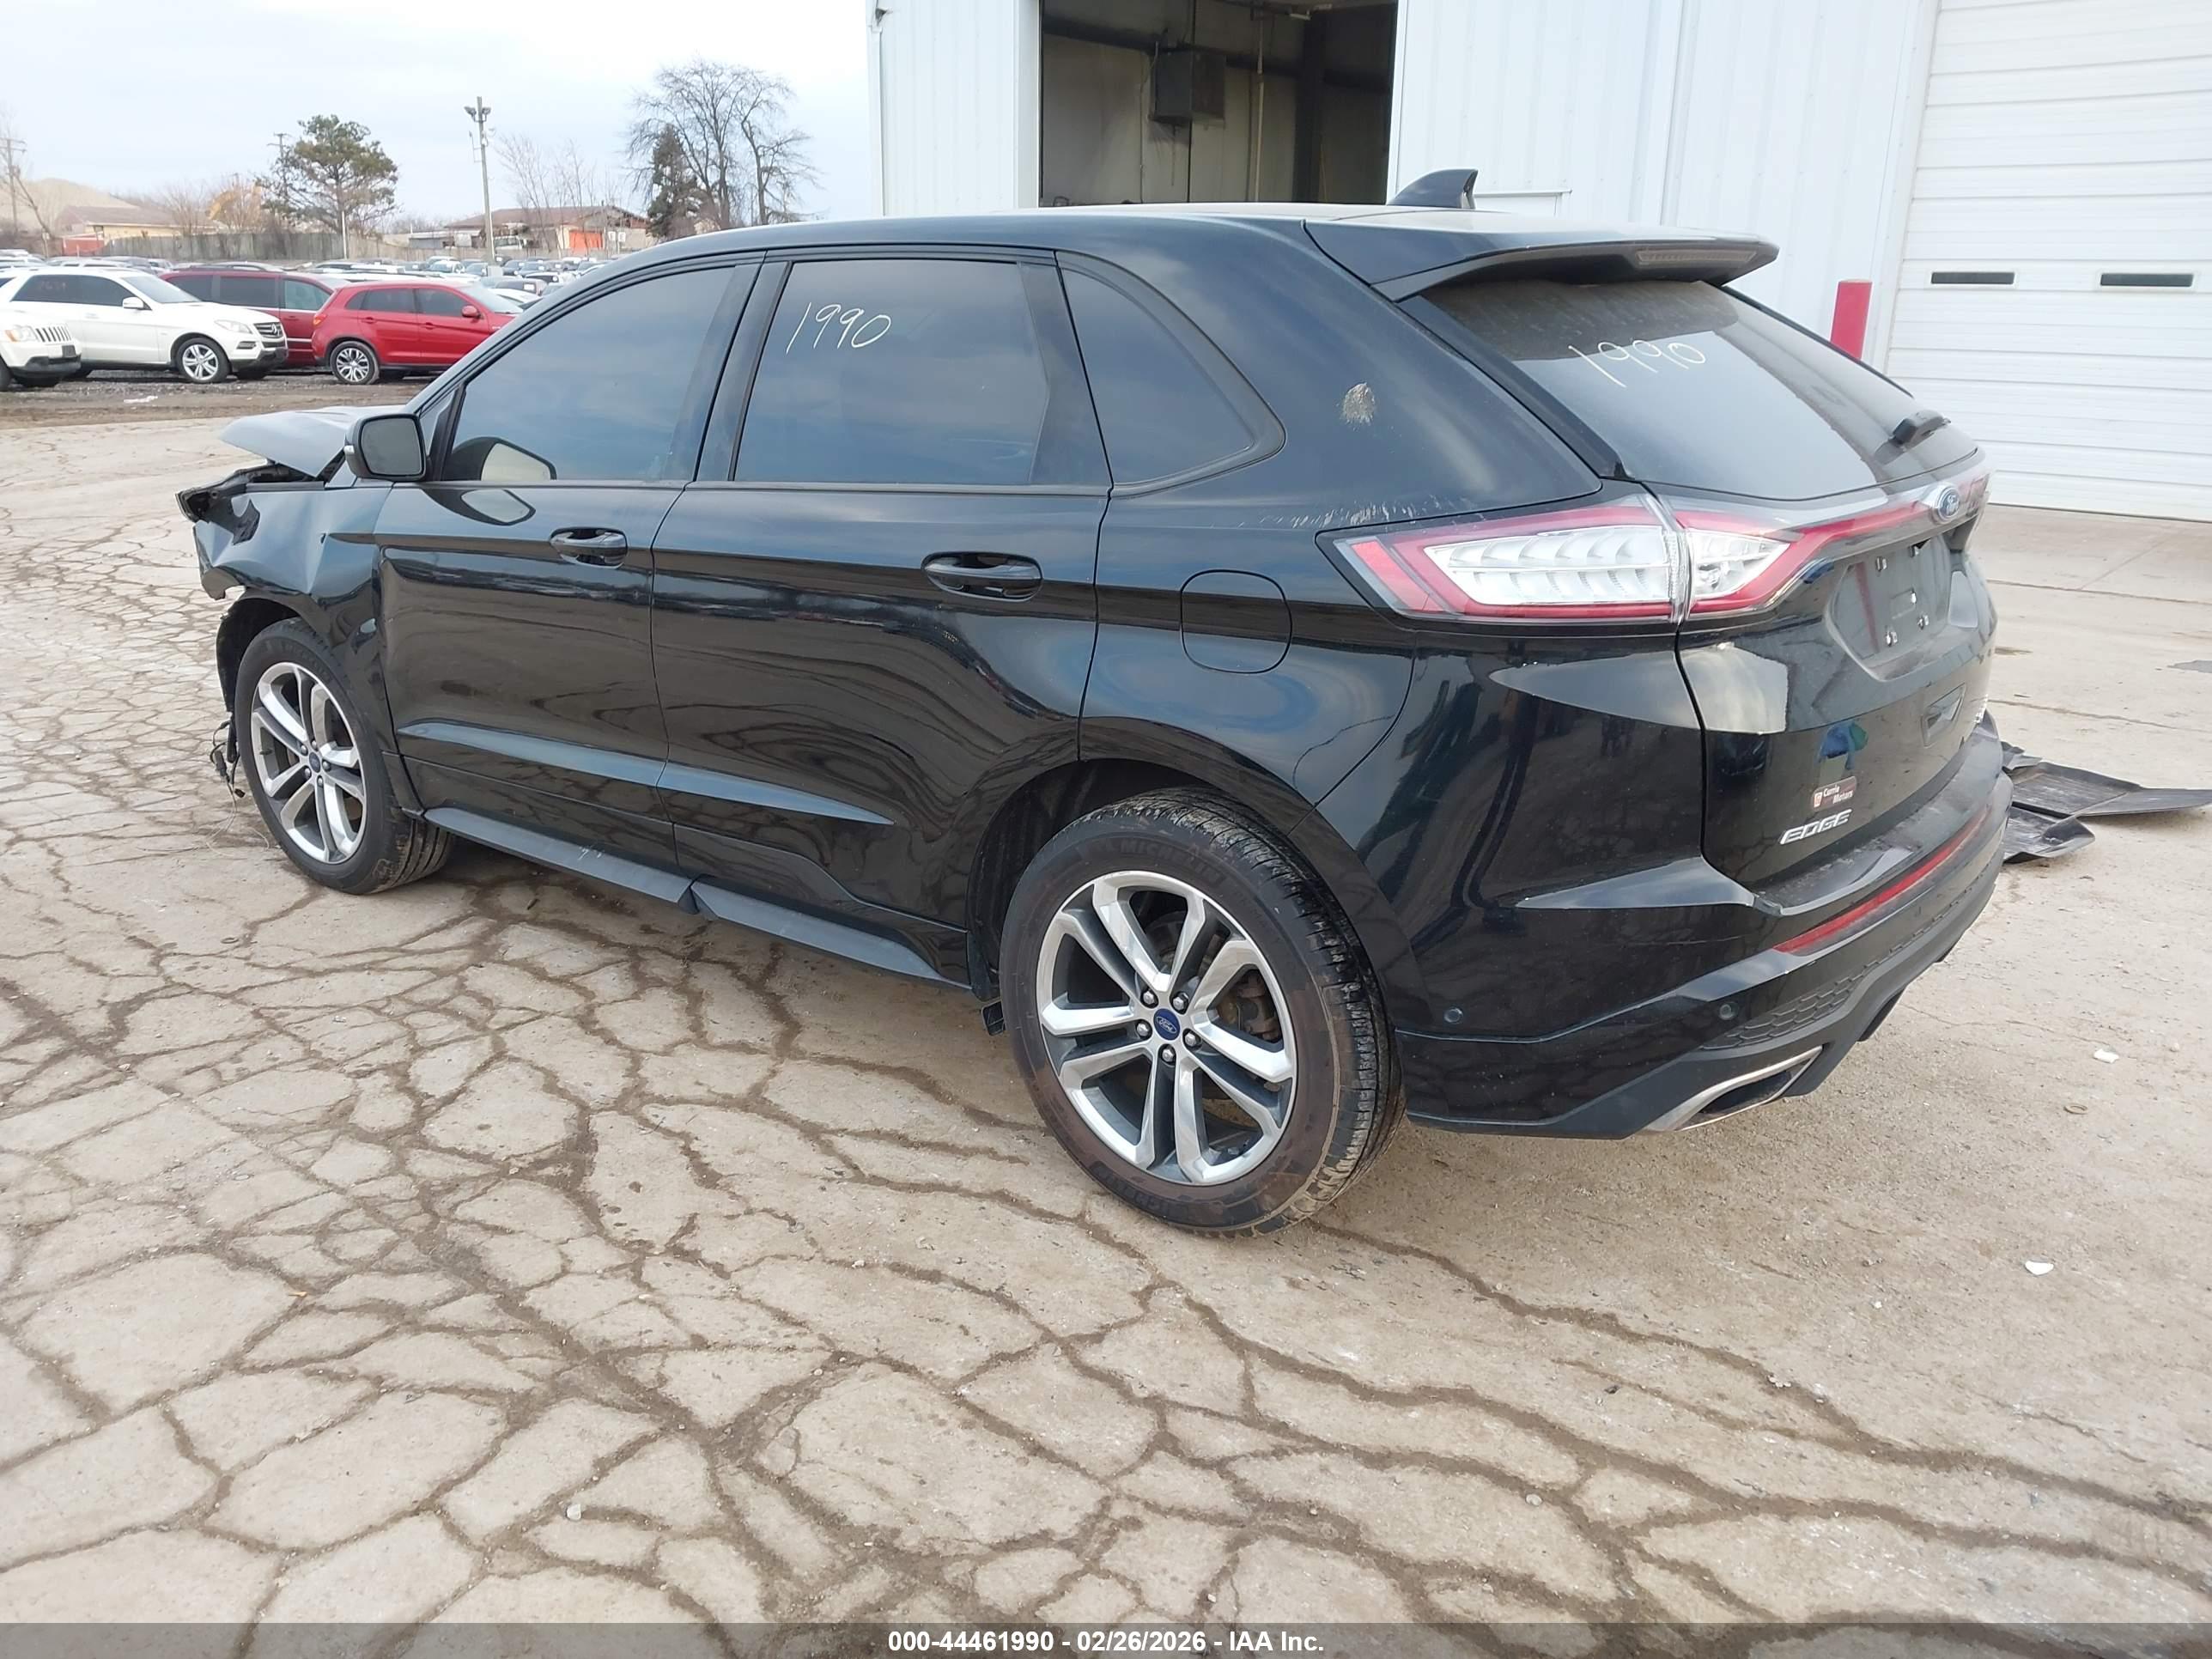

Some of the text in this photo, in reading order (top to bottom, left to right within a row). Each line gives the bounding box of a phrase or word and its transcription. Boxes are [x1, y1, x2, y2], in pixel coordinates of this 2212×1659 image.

[786, 302, 892, 355] 1990
[1568, 339, 1707, 388] 1990
[1779, 808, 1853, 845] EDGE
[1158, 1018, 1175, 1032] Ford
